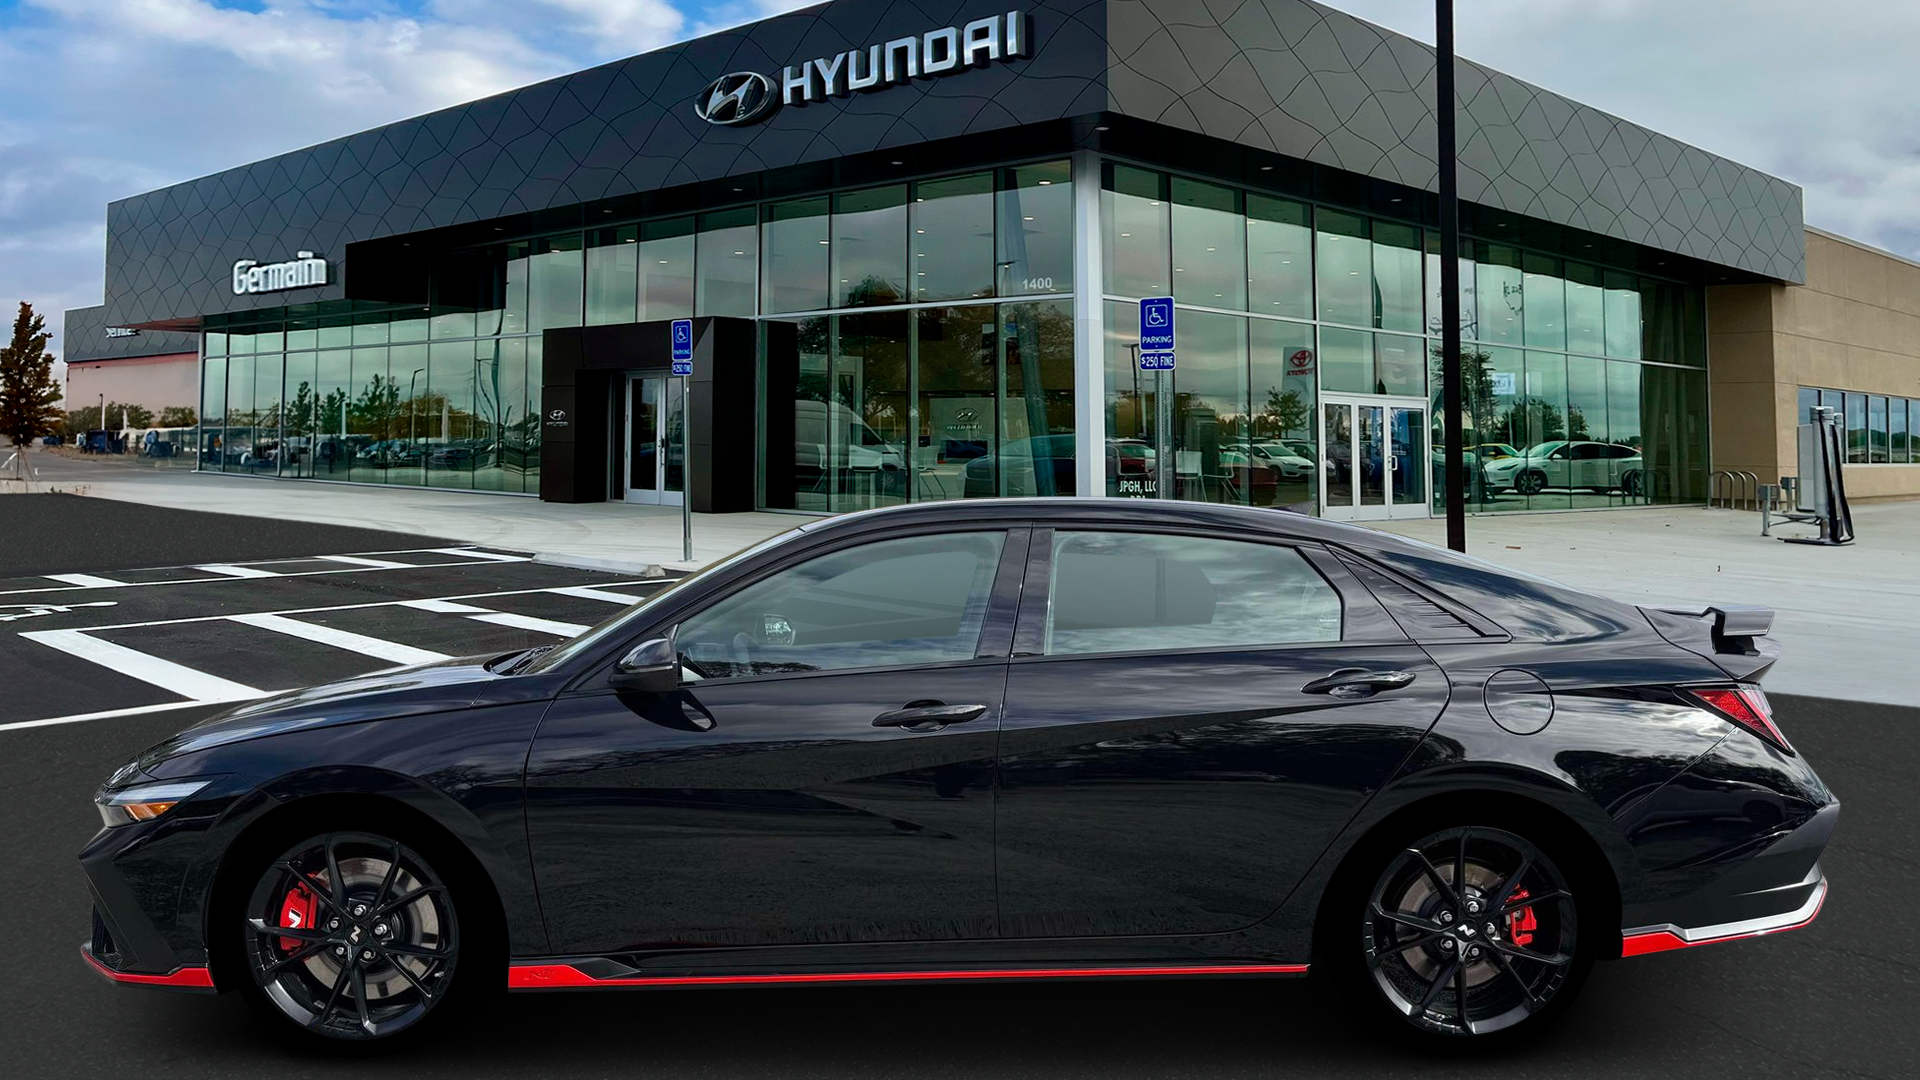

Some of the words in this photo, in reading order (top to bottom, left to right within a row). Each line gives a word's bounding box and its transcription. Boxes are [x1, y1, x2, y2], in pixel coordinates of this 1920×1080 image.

[783, 10, 1026, 105] HYUNDAI
[233, 250, 327, 294] Germain
[1022, 277, 1052, 290] 1400
[1142, 335, 1172, 344] PARKING
[1141, 356, 1158, 367] $250
[1160, 355, 1174, 367] FINE
[1119, 480, 1143, 494] JPGH,
